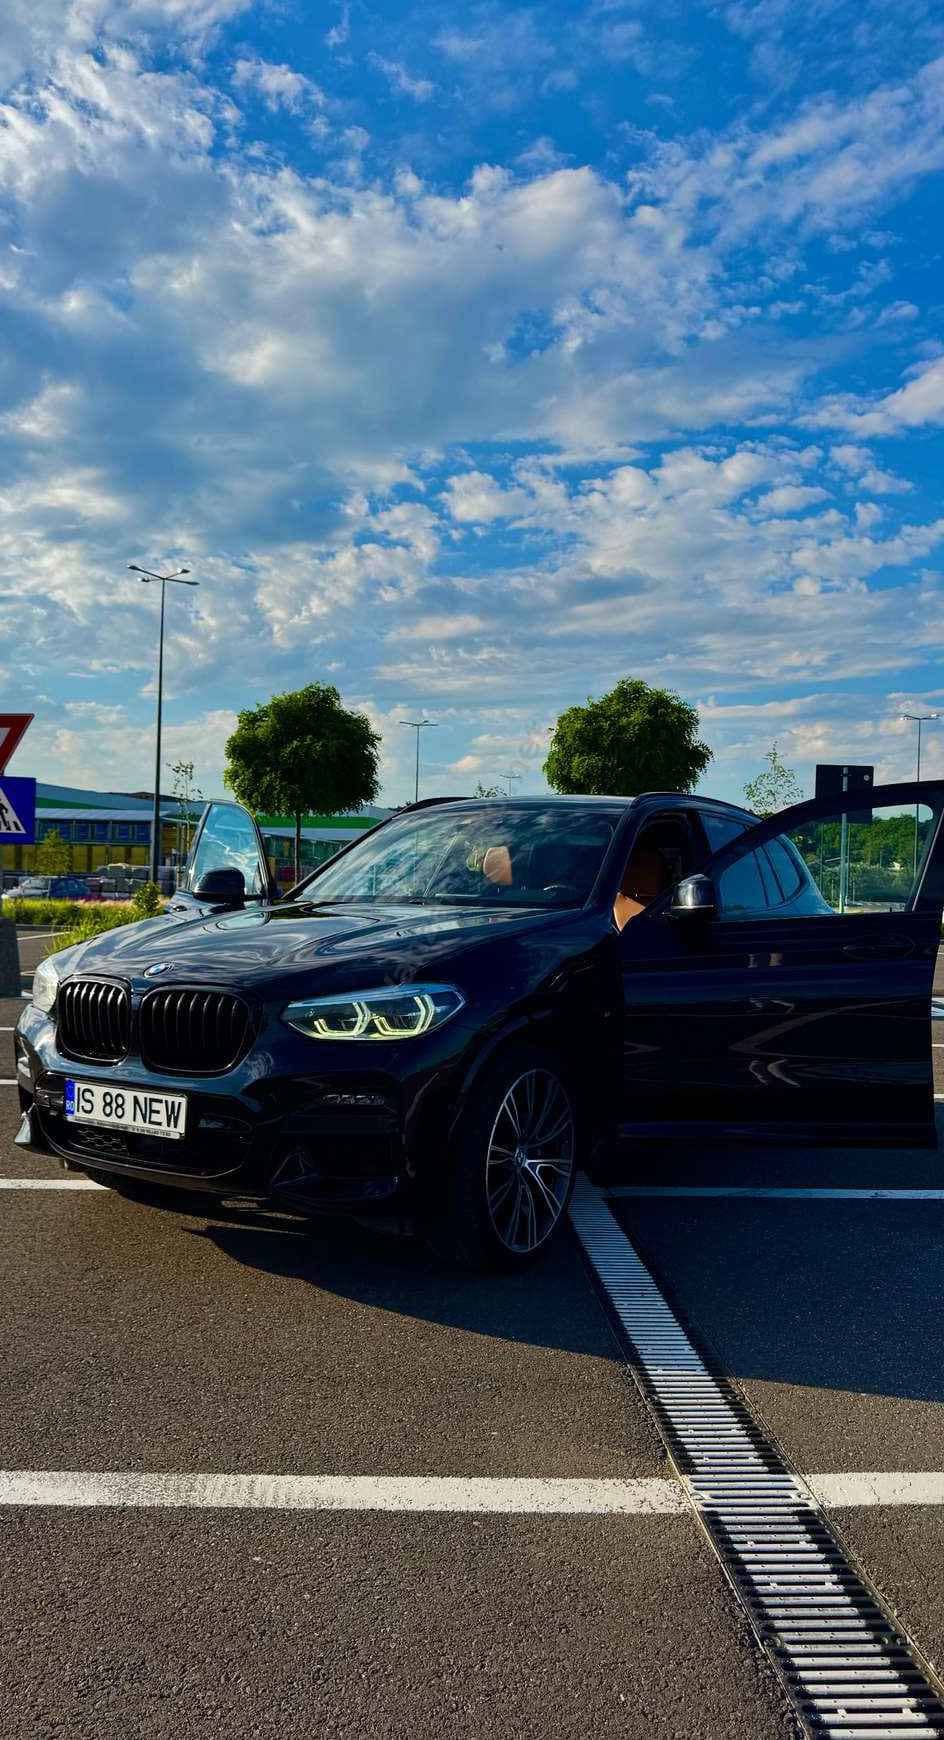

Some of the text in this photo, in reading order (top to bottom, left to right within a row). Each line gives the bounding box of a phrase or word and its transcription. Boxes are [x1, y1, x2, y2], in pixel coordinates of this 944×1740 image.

[76, 1087, 182, 1128] IS 88 NEW
